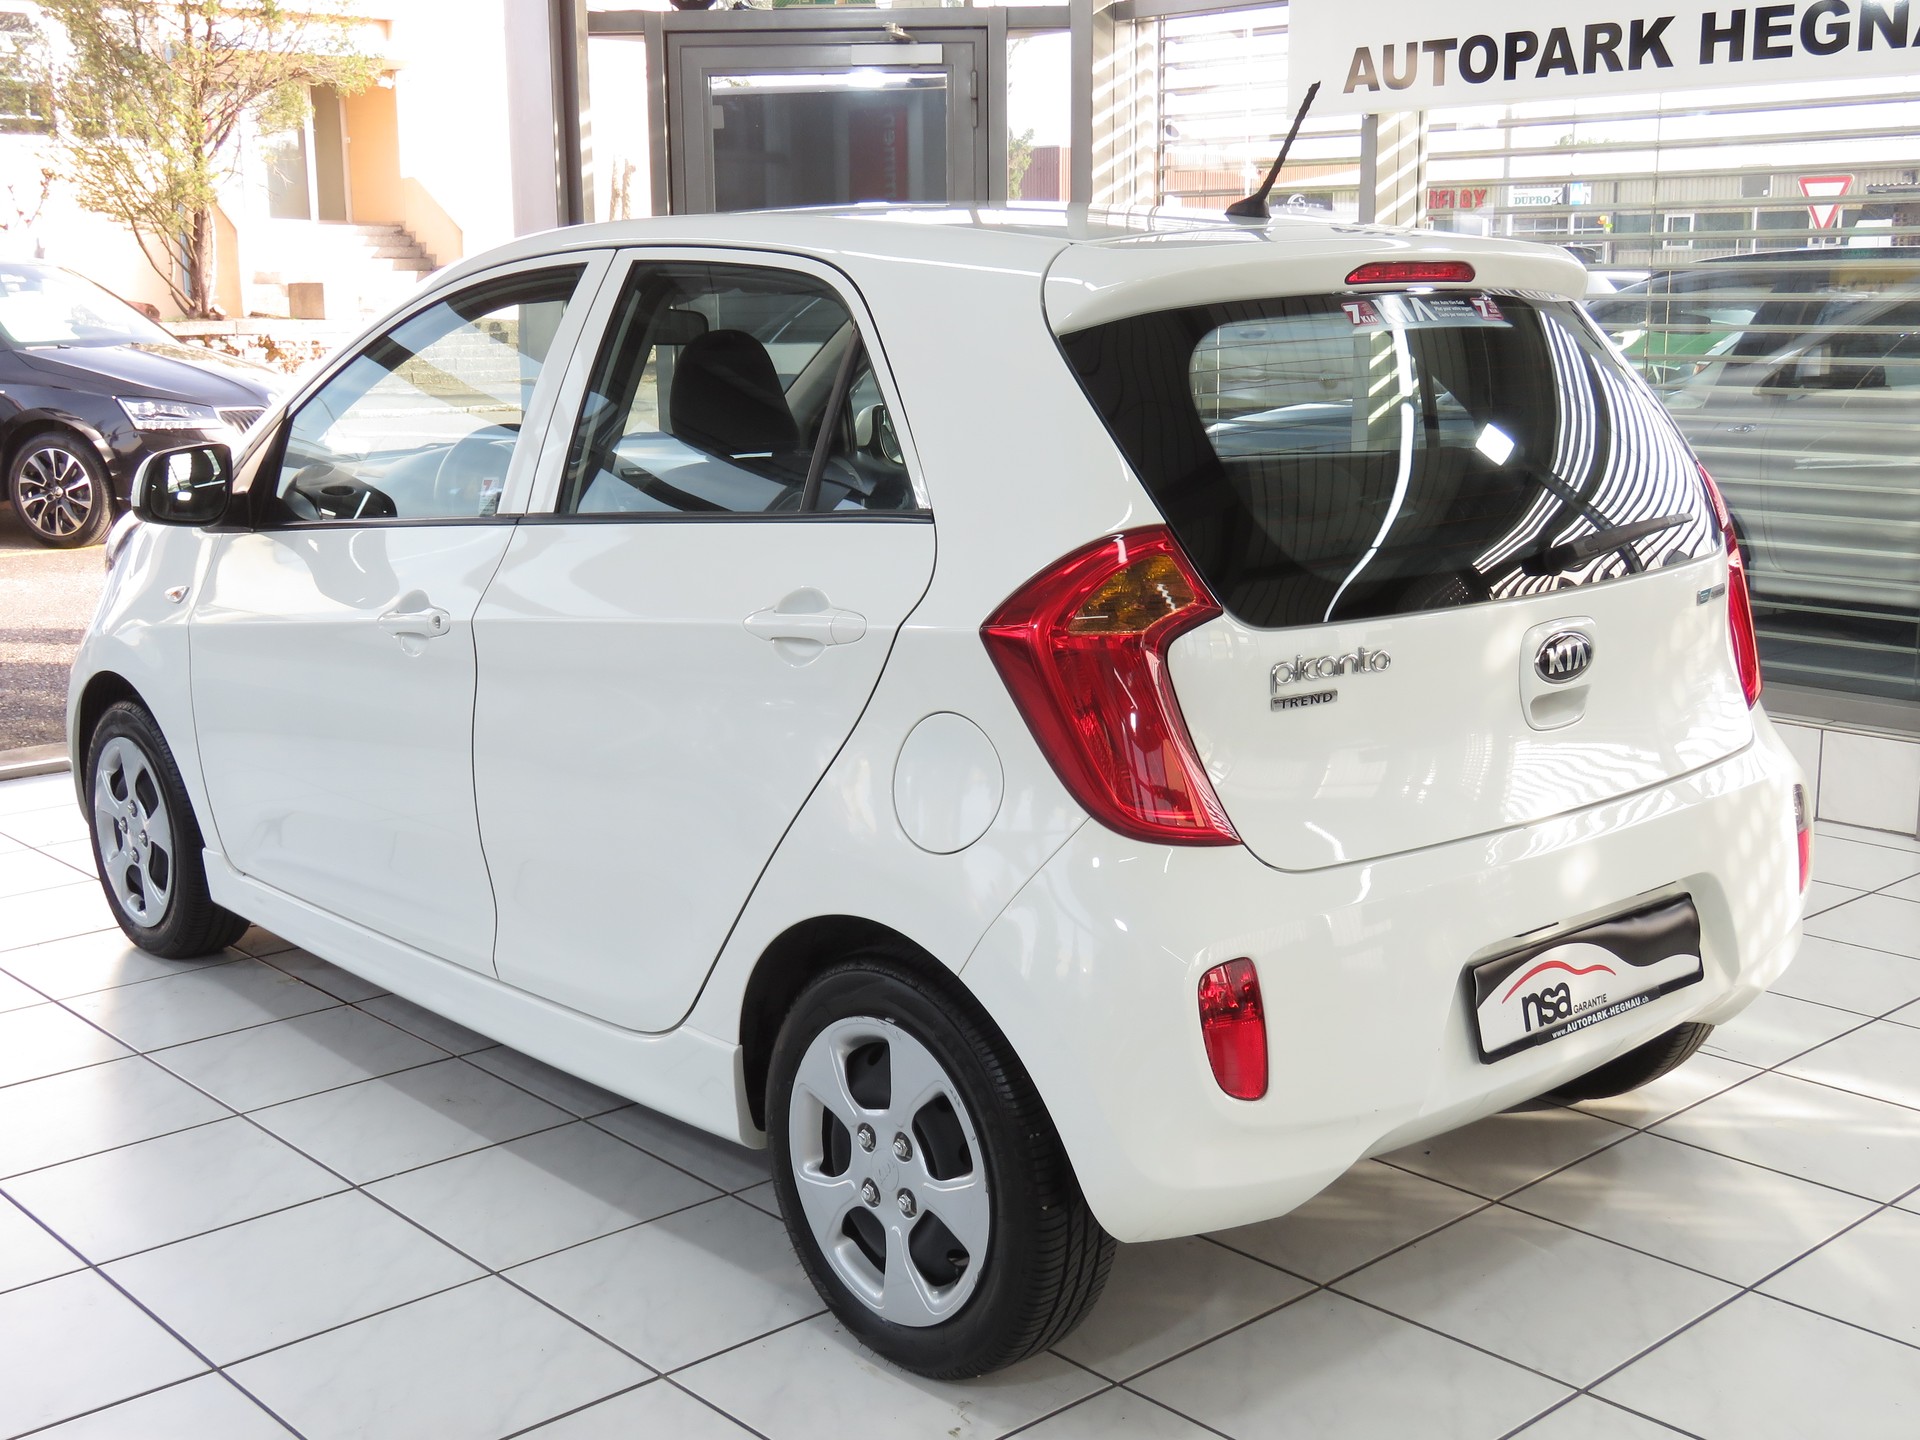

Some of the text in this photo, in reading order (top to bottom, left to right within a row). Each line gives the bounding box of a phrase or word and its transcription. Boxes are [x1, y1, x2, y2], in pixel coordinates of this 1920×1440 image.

[1342, 0, 1920, 95] AUTOPARK HEGN
[1513, 195, 1551, 205] DUPRO
[1360, 315, 1379, 324] KIA
[1270, 646, 1392, 695] picanto
[1546, 641, 1588, 675] KIA
[1281, 692, 1334, 709] TREND
[1521, 981, 1573, 1033] nsa
[1551, 995, 1650, 1039] www.AUTOPARK-HEGNAU.ch
[1573, 993, 1607, 1014] GARANTIE
